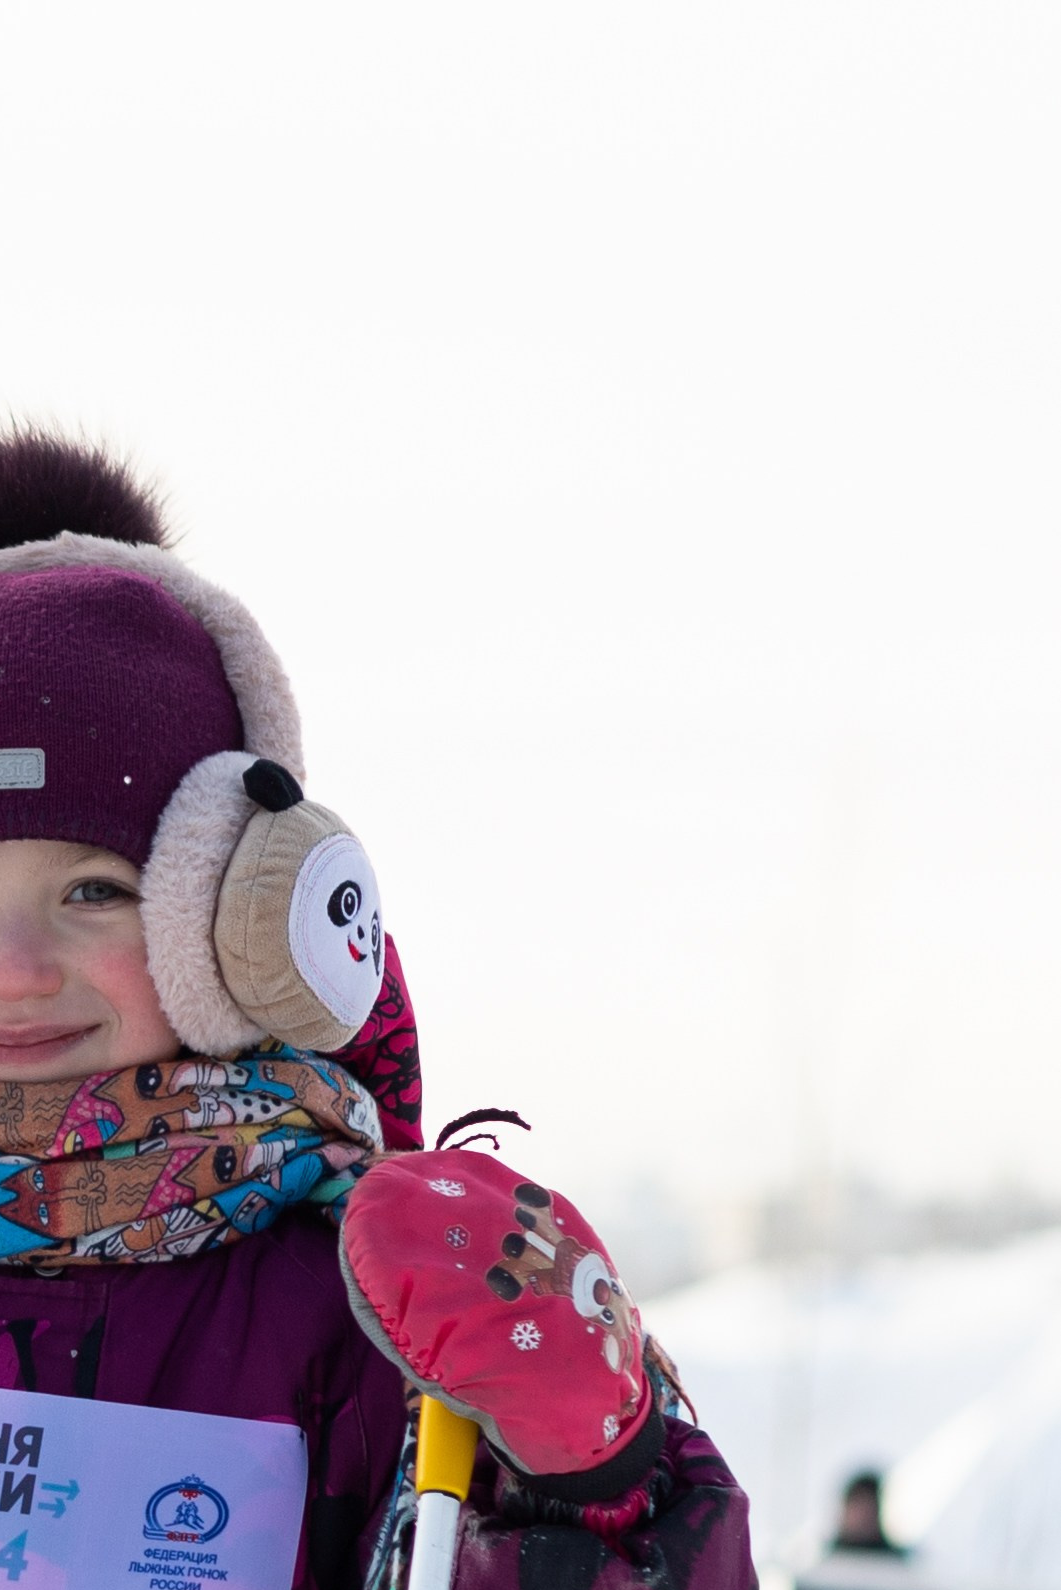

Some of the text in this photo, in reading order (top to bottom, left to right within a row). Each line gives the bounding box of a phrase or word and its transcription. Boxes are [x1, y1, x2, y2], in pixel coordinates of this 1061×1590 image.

[143, 1547, 218, 1565] ФЕДЕРАЦИЯ
[128, 1561, 229, 1581] ЛЫЖНЫХ ГОНОК
